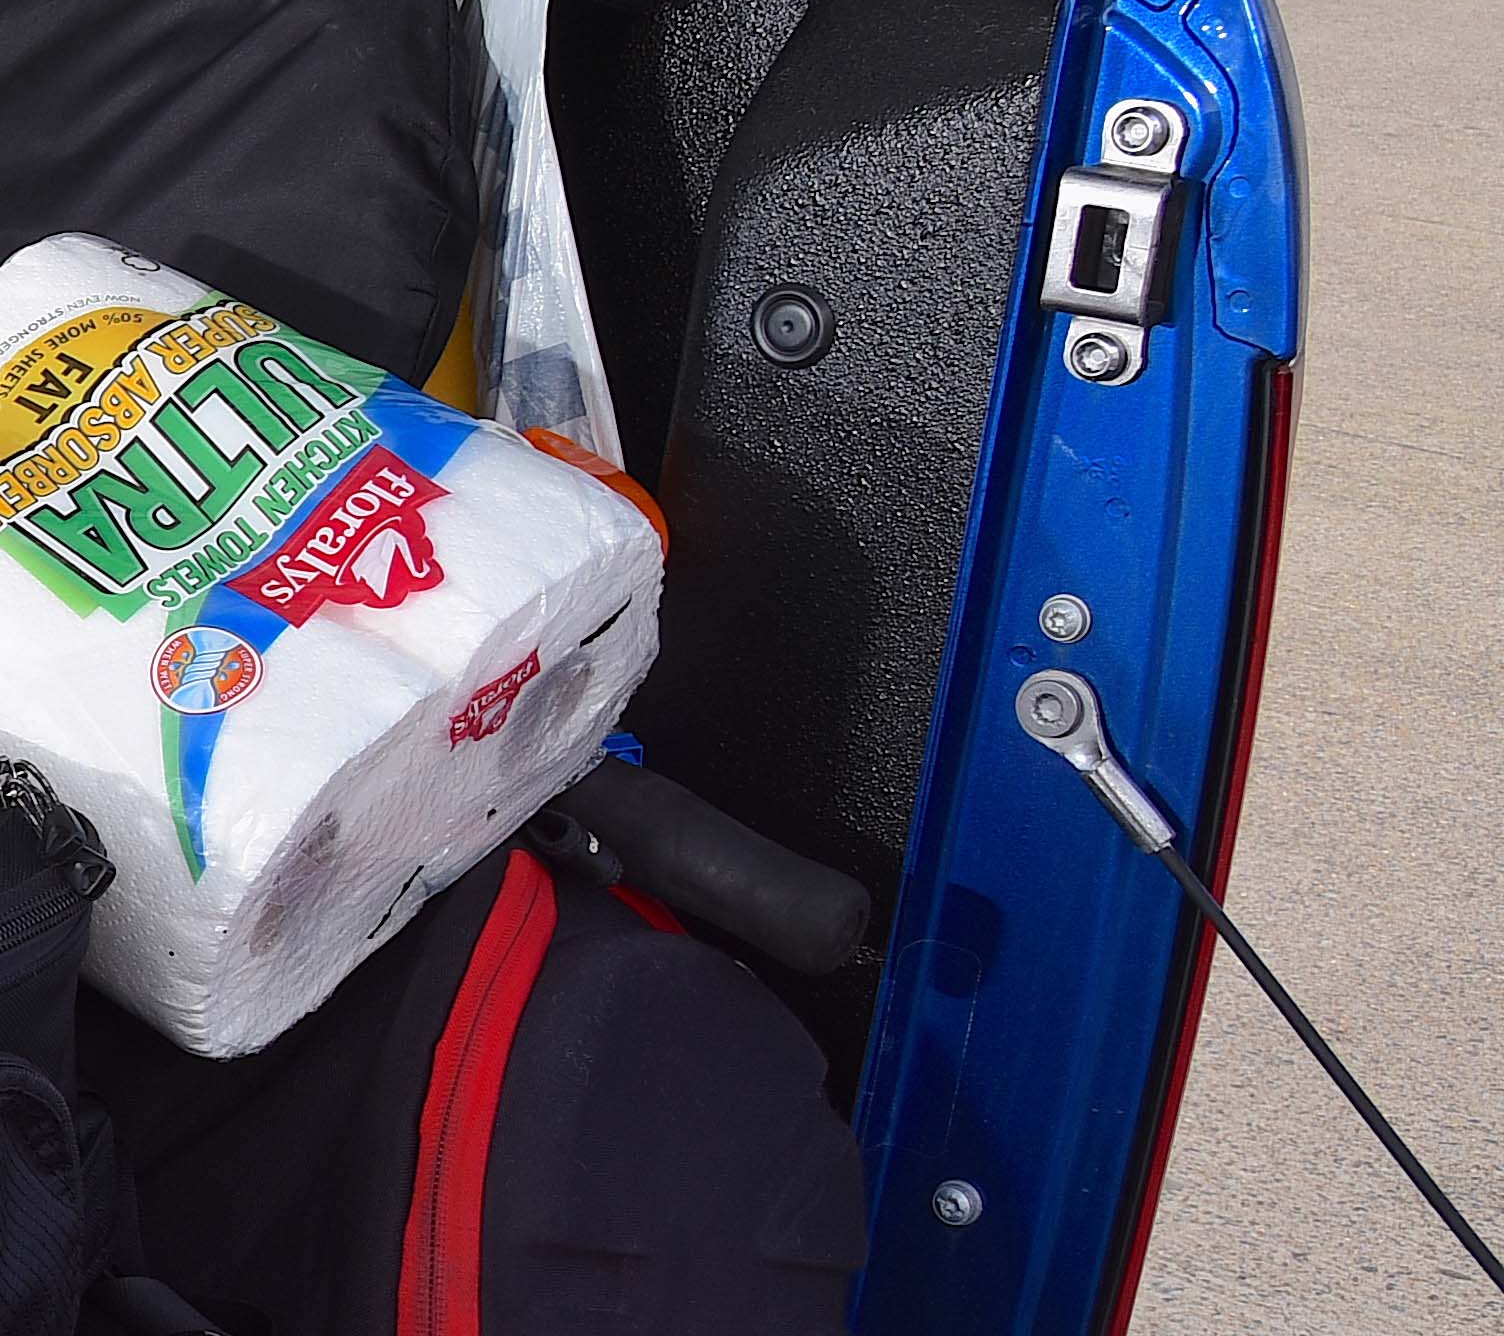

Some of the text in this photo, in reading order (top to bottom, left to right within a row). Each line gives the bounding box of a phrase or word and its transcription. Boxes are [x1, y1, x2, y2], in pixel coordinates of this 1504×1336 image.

[66, 294, 101, 311] EVEN
[102, 312, 143, 325] 50%
[105, 294, 141, 303] NOW
[44, 318, 97, 350] MORE
[145, 305, 279, 375] SUPER
[14, 352, 95, 424] FAT
[26, 340, 358, 589] ULTRA
[147, 409, 380, 608] KITCHEN TOWELS
[260, 466, 416, 605] floralys
[159, 640, 182, 691] WHEN WET
[220, 649, 253, 702] SUPER STRONG
[454, 661, 533, 735] floralys
